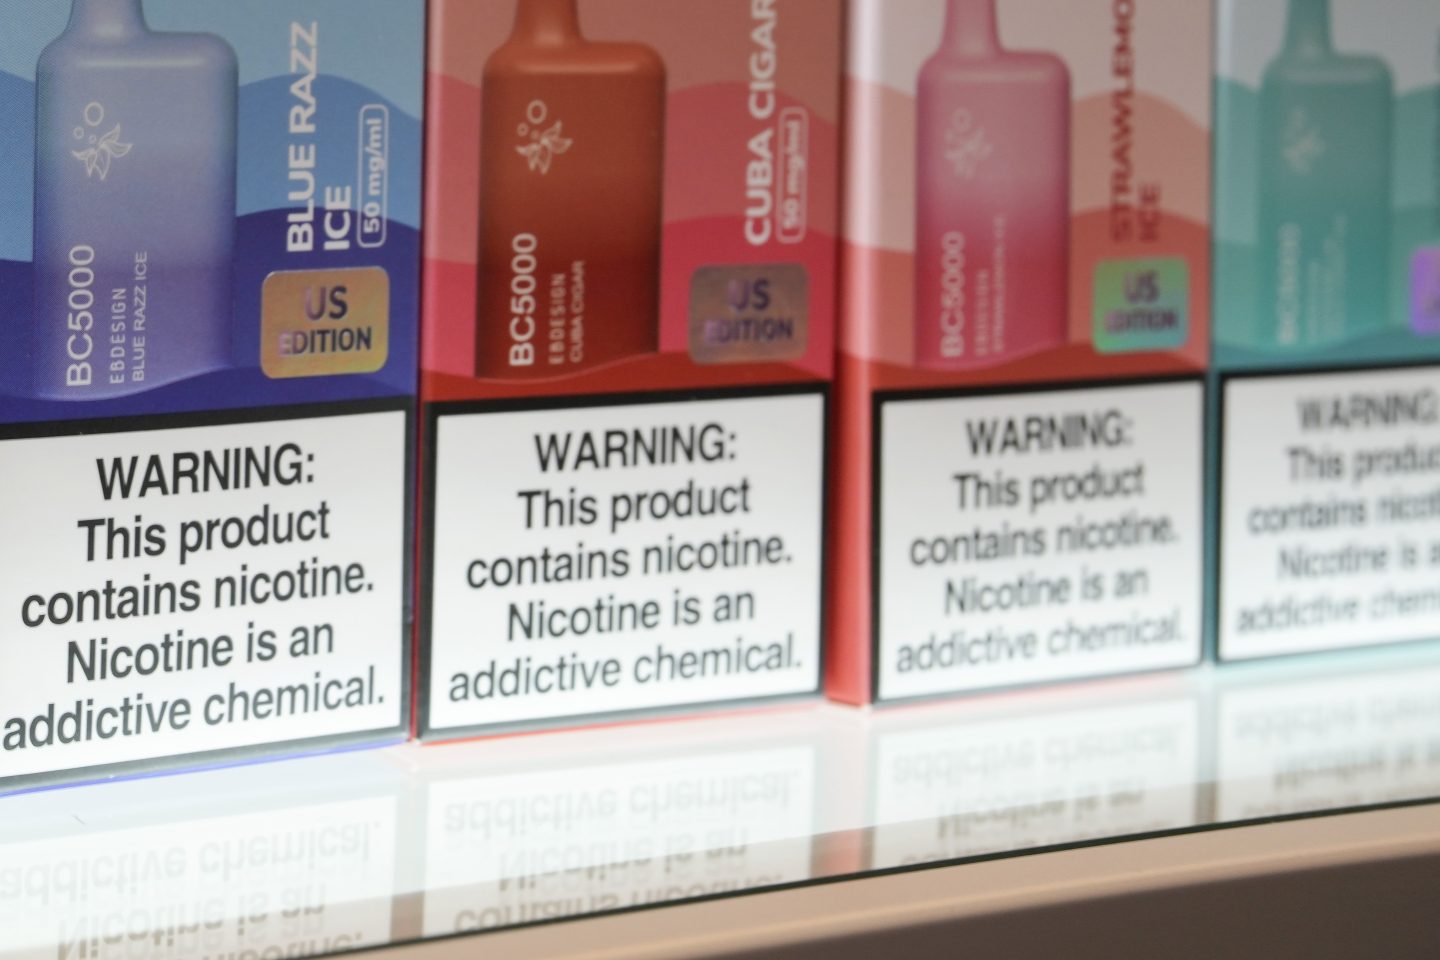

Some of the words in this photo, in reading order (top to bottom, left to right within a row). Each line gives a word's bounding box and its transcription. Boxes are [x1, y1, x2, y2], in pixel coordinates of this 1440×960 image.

[289, 21, 318, 134] RAZZ
[366, 117, 385, 196] mg/ml
[286, 143, 316, 252] BLUE
[745, 128, 773, 245] CUBA
[323, 185, 352, 250] ICE
[363, 201, 380, 234] 50
[134, 251, 148, 281] ICE
[729, 279, 771, 311] US
[66, 245, 95, 387] BC5000
[133, 285, 147, 331] RAZZ
[305, 285, 349, 321] US
[509, 233, 537, 367] BC5000
[110, 288, 127, 384] EBDESIGN
[132, 336, 145, 381] BLUE
[278, 326, 372, 357] EDITION
[705, 318, 793, 344] EDITION
[534, 423, 736, 472] WARNING:
[965, 409, 1133, 458] WARNING:
[96, 442, 315, 501] WARNING:
[953, 471, 1020, 509] This
[1030, 461, 1144, 515] product
[77, 514, 167, 562] This
[179, 500, 331, 565] product
[517, 488, 598, 529] This
[611, 478, 750, 533] product
[467, 543, 629, 589] contains
[643, 530, 792, 575] nicotine.
[909, 522, 1046, 565] contains
[1056, 511, 1179, 551] nicotine.
[21, 574, 201, 628] contains
[214, 557, 374, 609] nicotine.
[508, 594, 660, 642] Nicotine
[673, 589, 700, 627] is
[713, 590, 755, 623] an
[945, 570, 1070, 615] Nicotine
[1079, 565, 1103, 601] is
[1114, 567, 1148, 598] an
[66, 629, 233, 684] Nicotine
[246, 622, 277, 664] is
[289, 621, 335, 658] an
[449, 653, 620, 702] addictive
[633, 632, 803, 684] chemical.
[896, 626, 1038, 672] addictive
[1047, 609, 1182, 656] chemical.
[3, 693, 191, 752] addictive
[203, 665, 385, 726] chemical.
